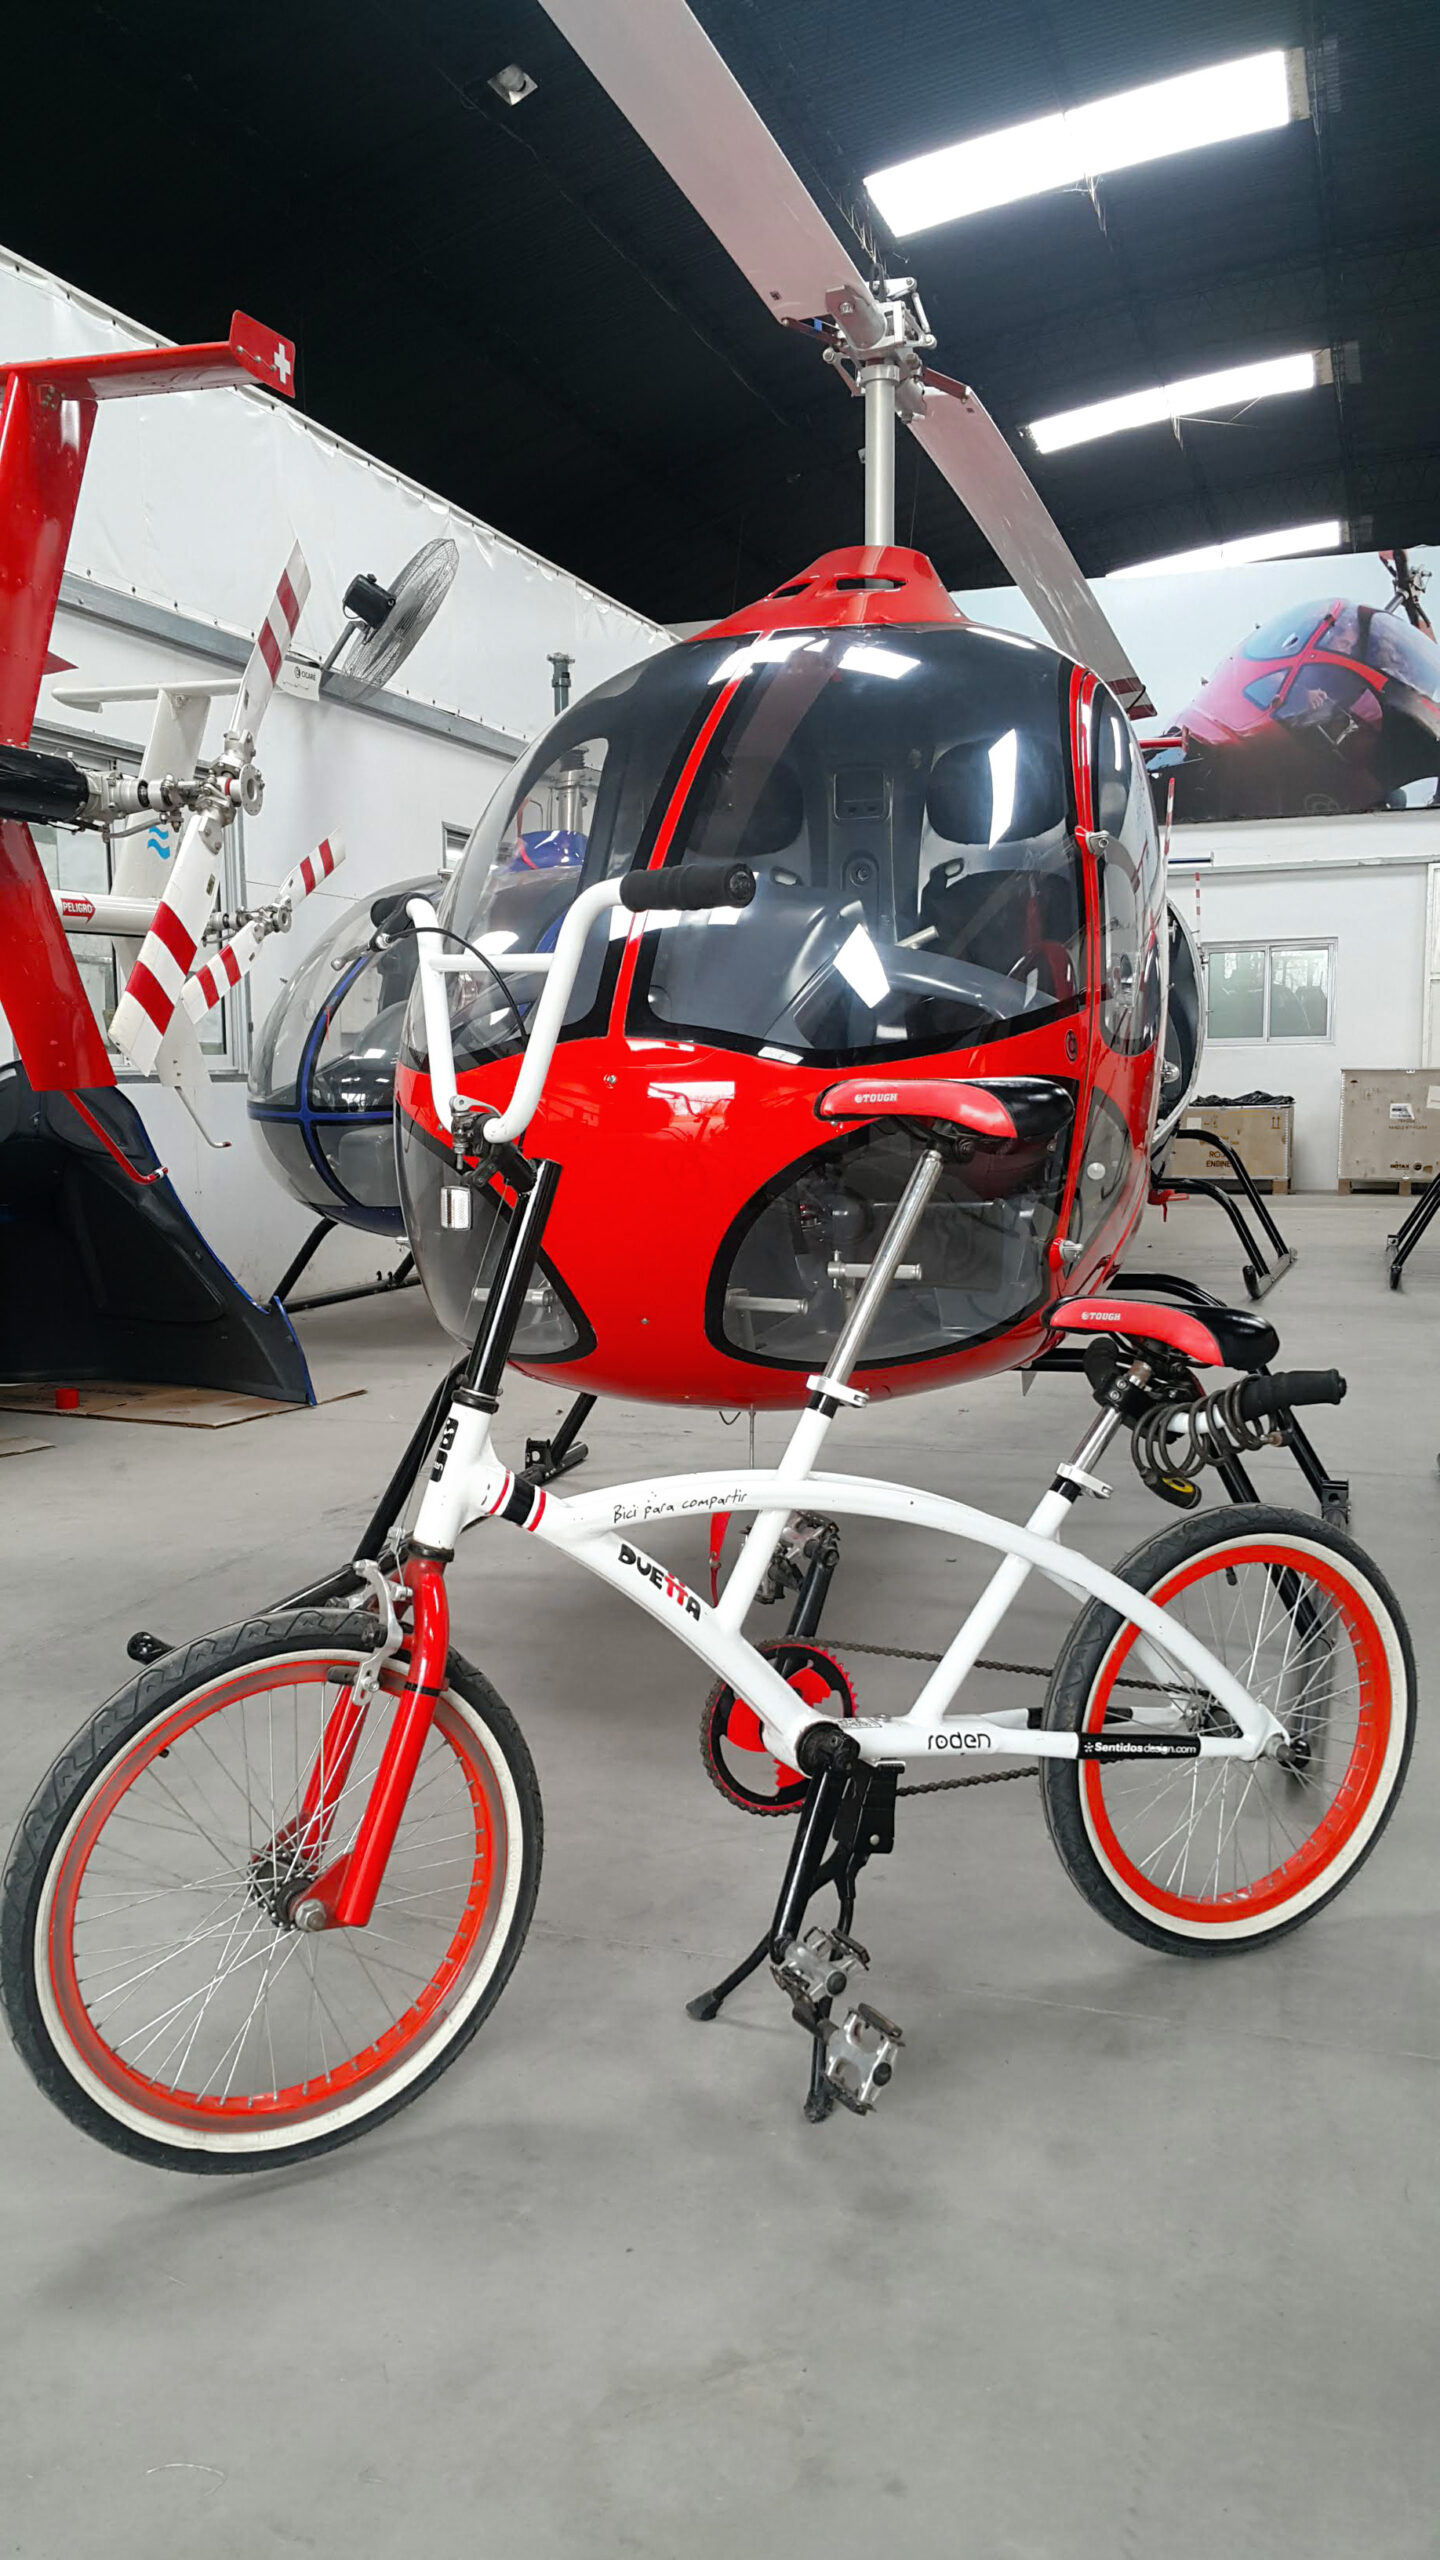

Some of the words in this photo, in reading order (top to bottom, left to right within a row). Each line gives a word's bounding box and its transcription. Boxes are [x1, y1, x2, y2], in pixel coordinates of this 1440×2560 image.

[63, 901, 93, 913] PELIGRO
[862, 1093, 898, 1103] TOUGH
[1089, 1311, 1121, 1321] TOUGH
[613, 1504, 638, 1524] Bici
[644, 1502, 675, 1519] para
[682, 1489, 748, 1509] compartir
[618, 1543, 701, 1622] DUETTA
[928, 1731, 992, 1750] roden
